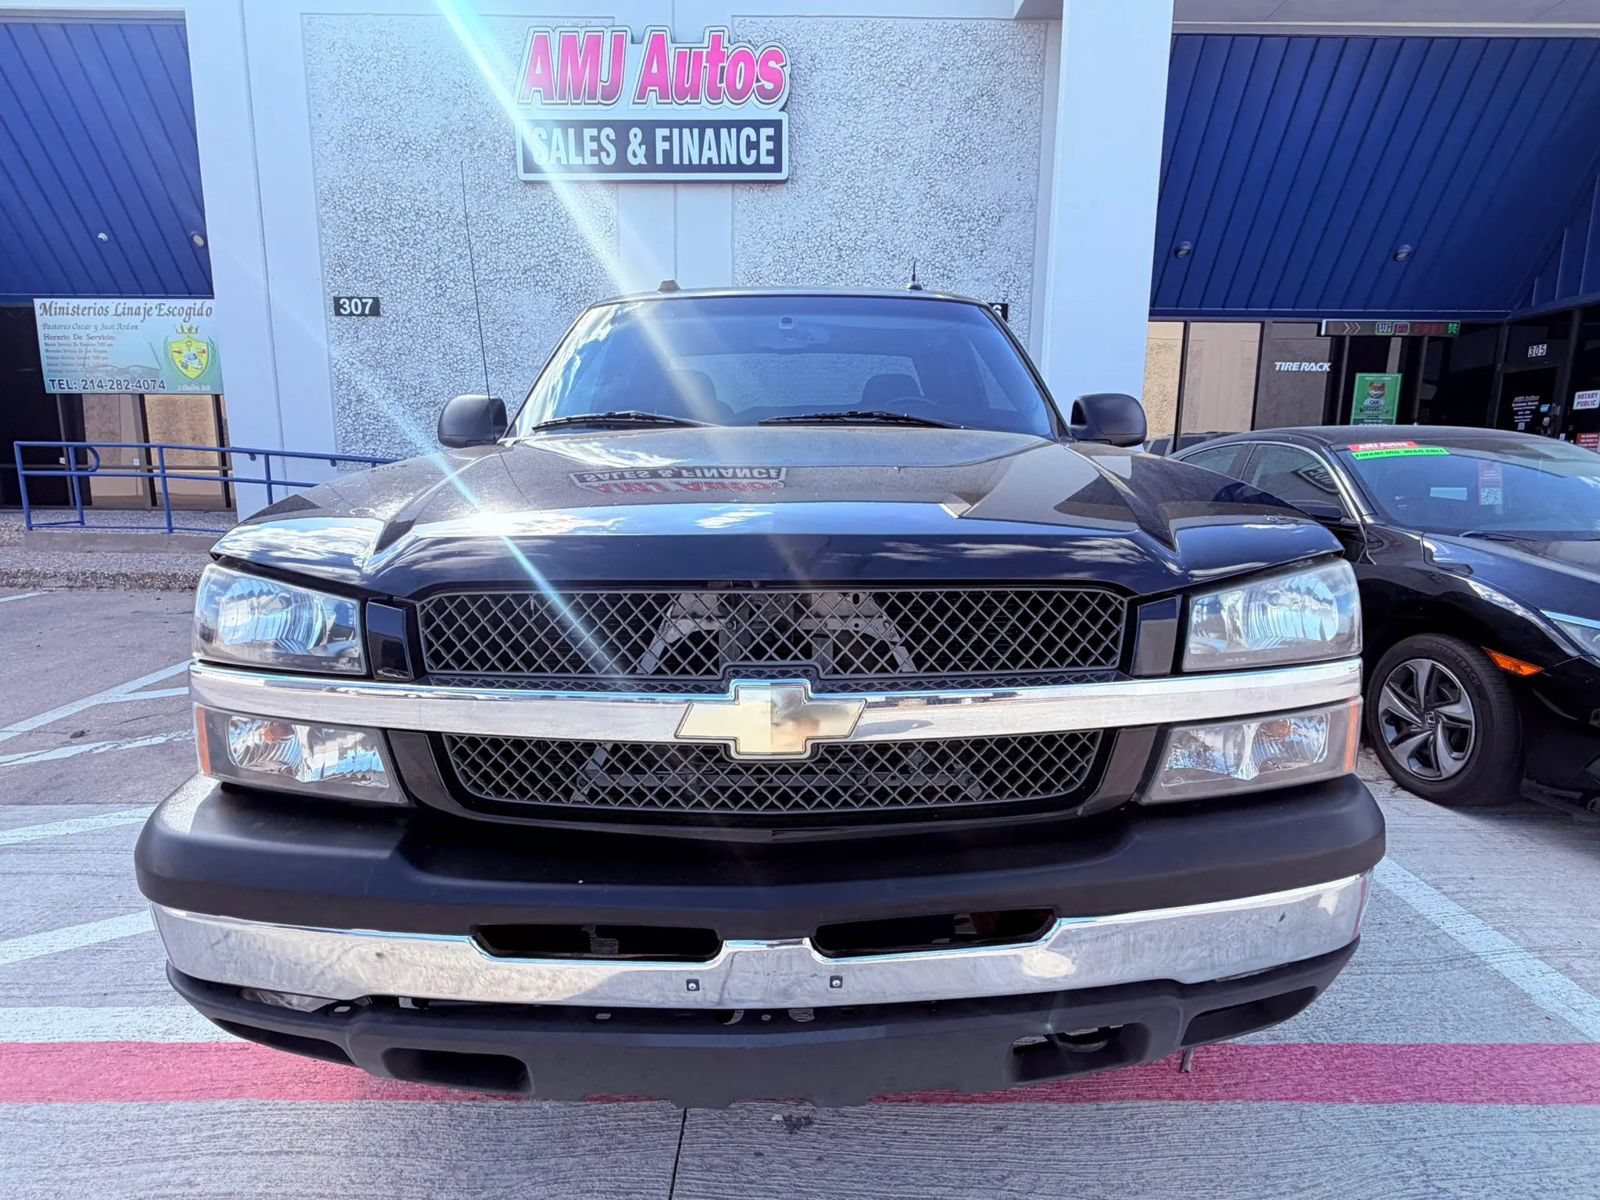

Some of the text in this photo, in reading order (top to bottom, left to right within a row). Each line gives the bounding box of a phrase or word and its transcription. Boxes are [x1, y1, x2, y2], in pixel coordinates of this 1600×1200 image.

[519, 31, 786, 105] AMJ Autos
[532, 127, 775, 166] SALES & FINANCE
[39, 301, 213, 323] Ministerios Linaje Escogido
[340, 298, 373, 315] 307
[1528, 344, 1547, 357] 305
[49, 379, 77, 390] TEL:
[81, 379, 166, 390] 214-282-4074
